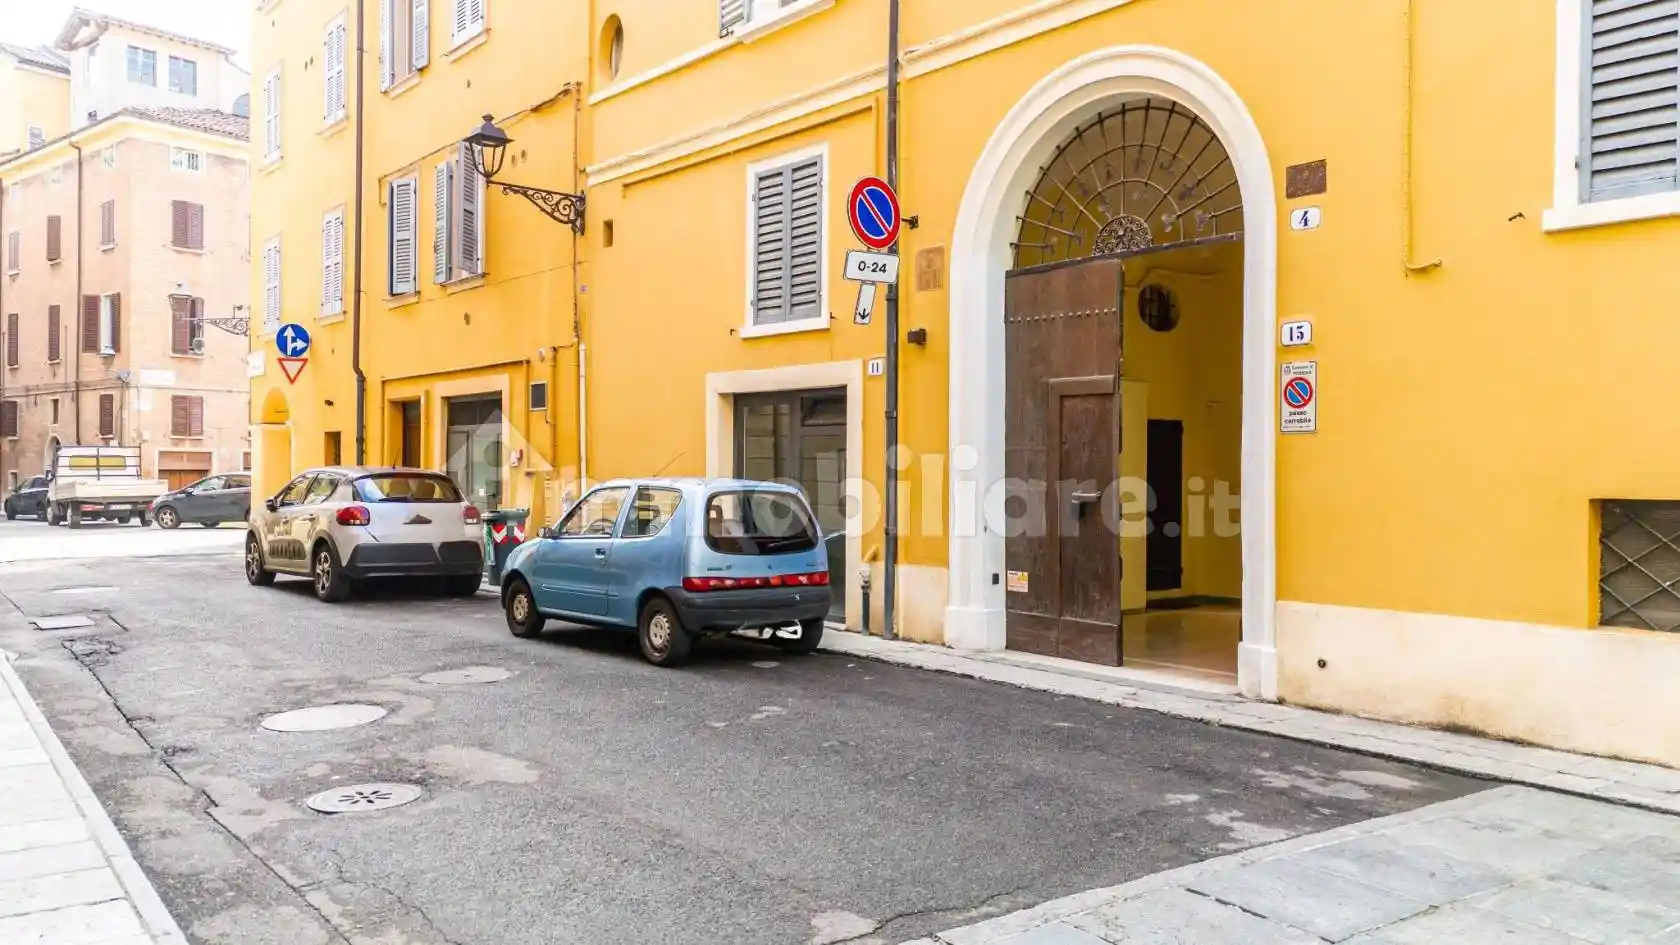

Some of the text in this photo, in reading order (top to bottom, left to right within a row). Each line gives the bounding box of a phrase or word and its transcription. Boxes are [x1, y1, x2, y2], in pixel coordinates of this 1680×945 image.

[1298, 210, 1310, 227] 4
[858, 260, 887, 274] 0-24
[1289, 325, 1305, 342] 15
[871, 361, 879, 374] 11
